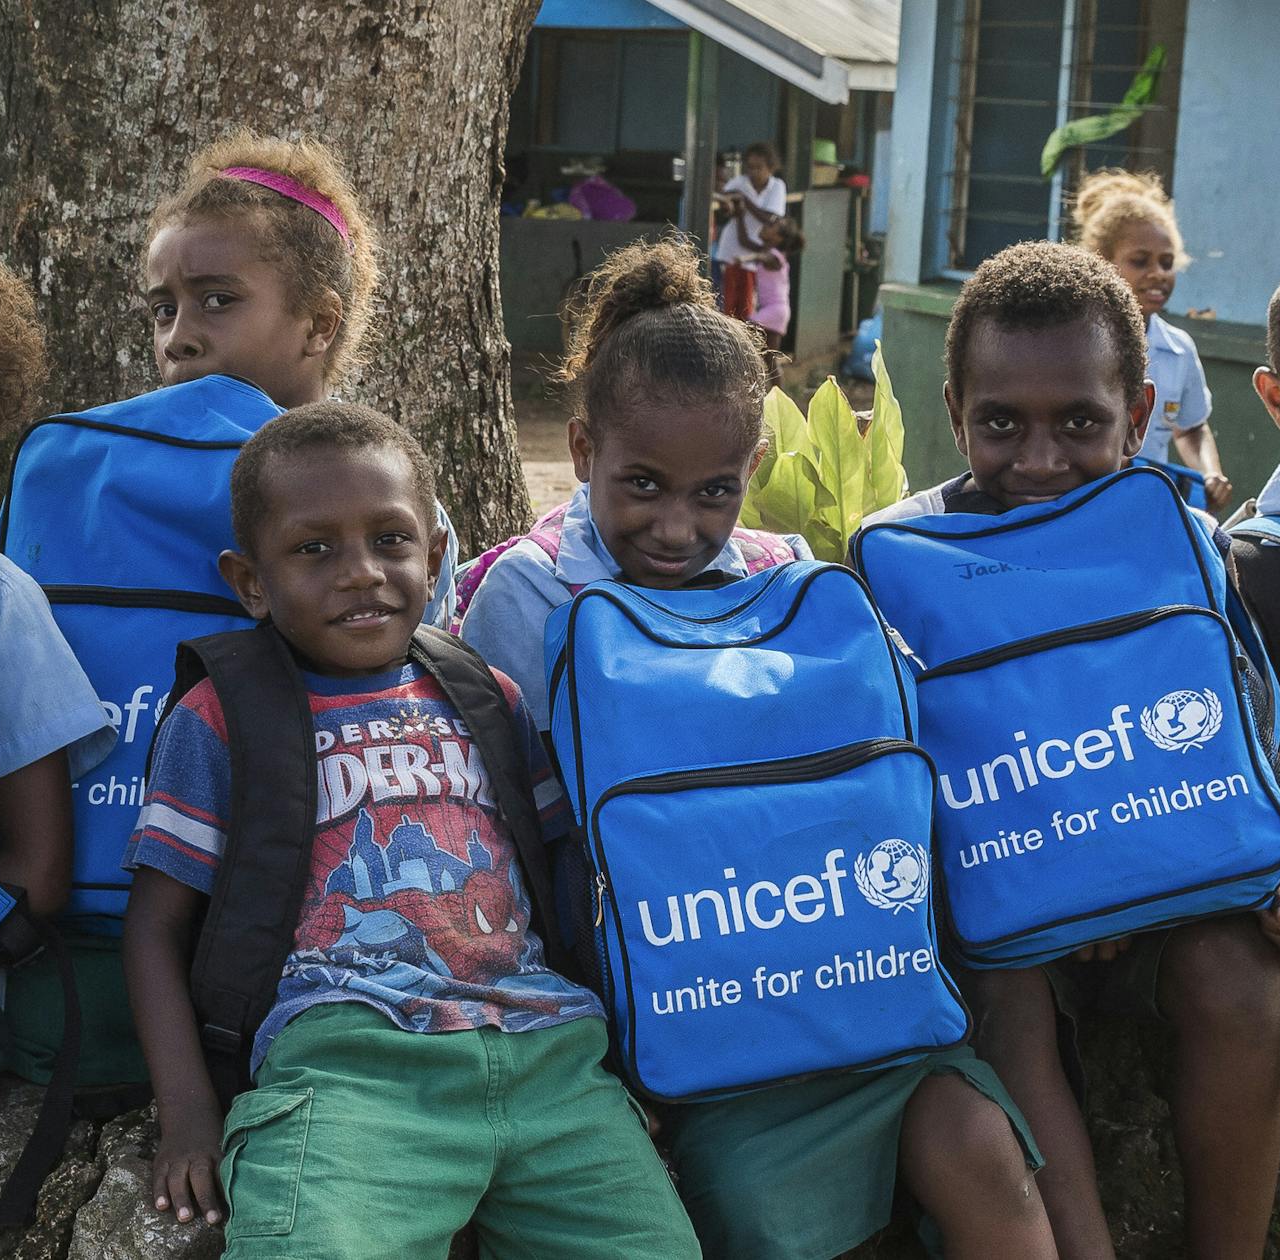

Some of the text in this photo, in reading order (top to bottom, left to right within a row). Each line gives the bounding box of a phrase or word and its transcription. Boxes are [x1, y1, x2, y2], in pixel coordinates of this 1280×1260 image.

[939, 704, 1135, 810] unicef
[960, 773, 1249, 869] unite for children
[638, 848, 847, 947] unicef
[651, 945, 936, 1015] unite for childre
